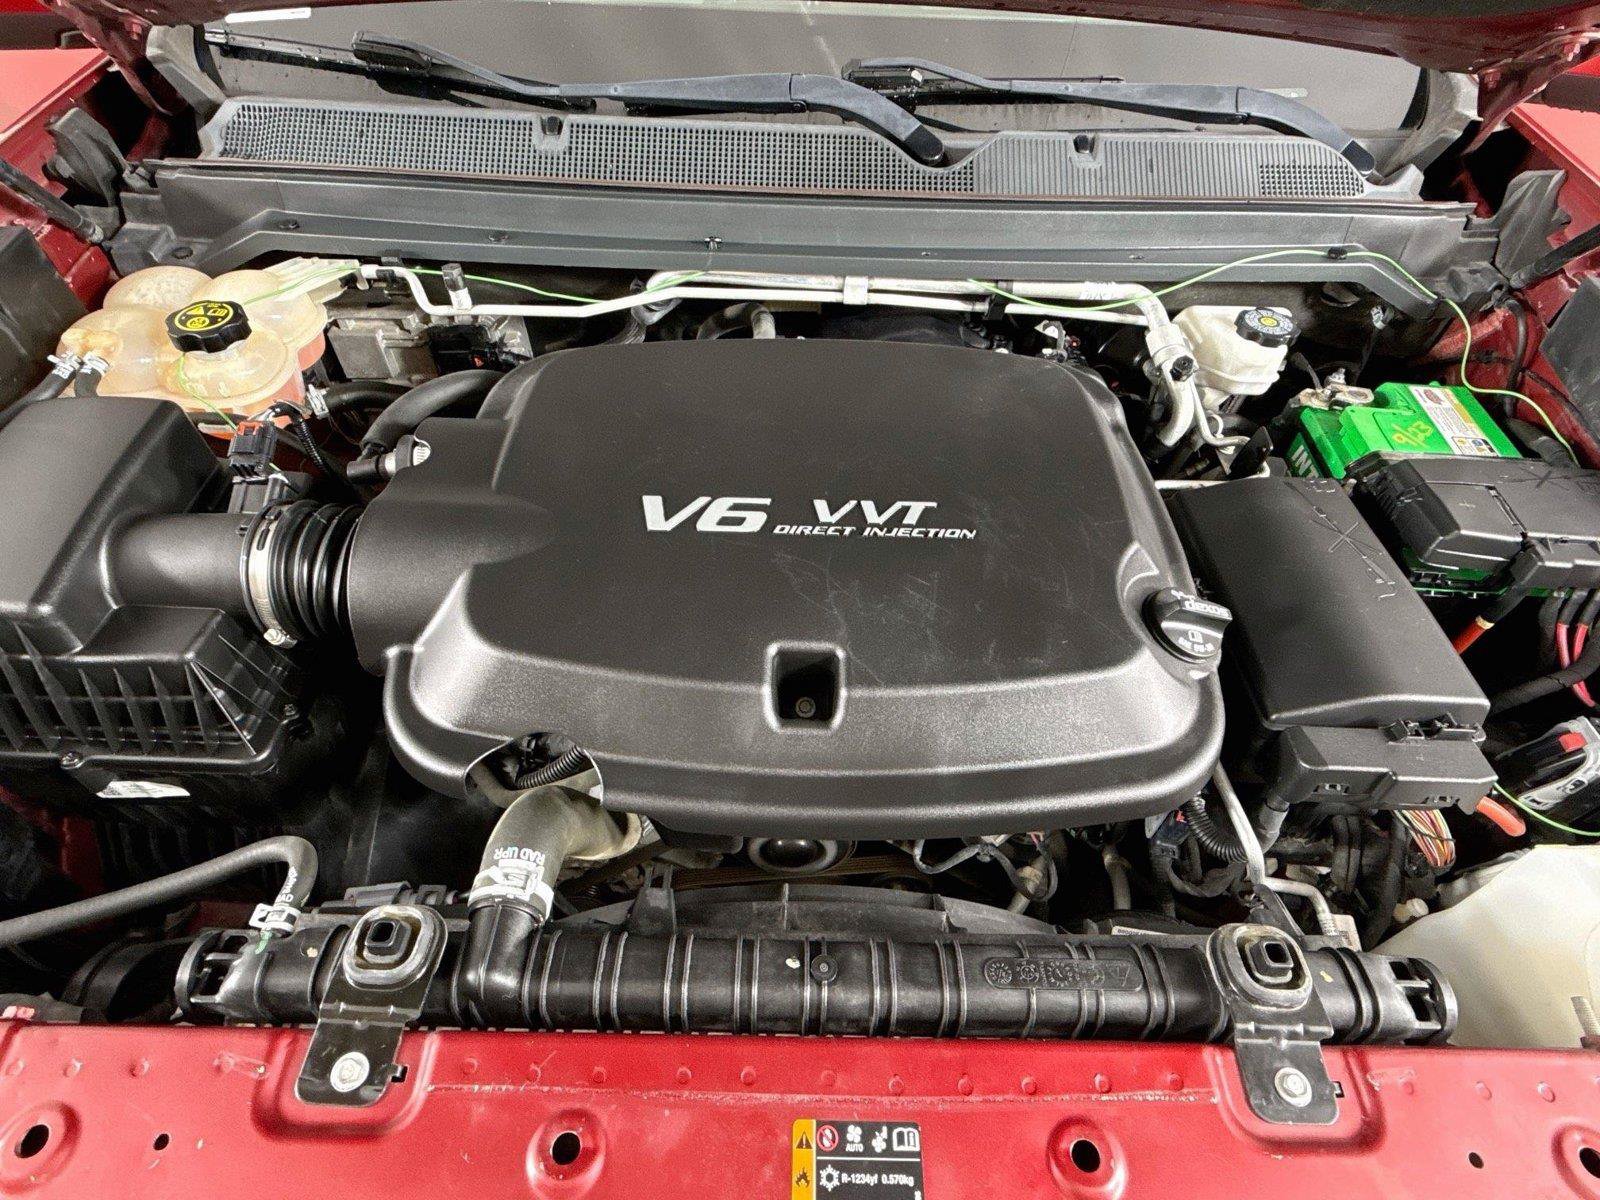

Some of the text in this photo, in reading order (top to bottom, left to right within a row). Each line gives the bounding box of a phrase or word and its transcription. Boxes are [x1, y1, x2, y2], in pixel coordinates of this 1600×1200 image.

[642, 495, 772, 533] V6
[813, 499, 938, 526] VVT
[773, 525, 976, 539] DIRECT INJECTION
[520, 847, 546, 866] RAD
[845, 1143, 864, 1152] AUTO
